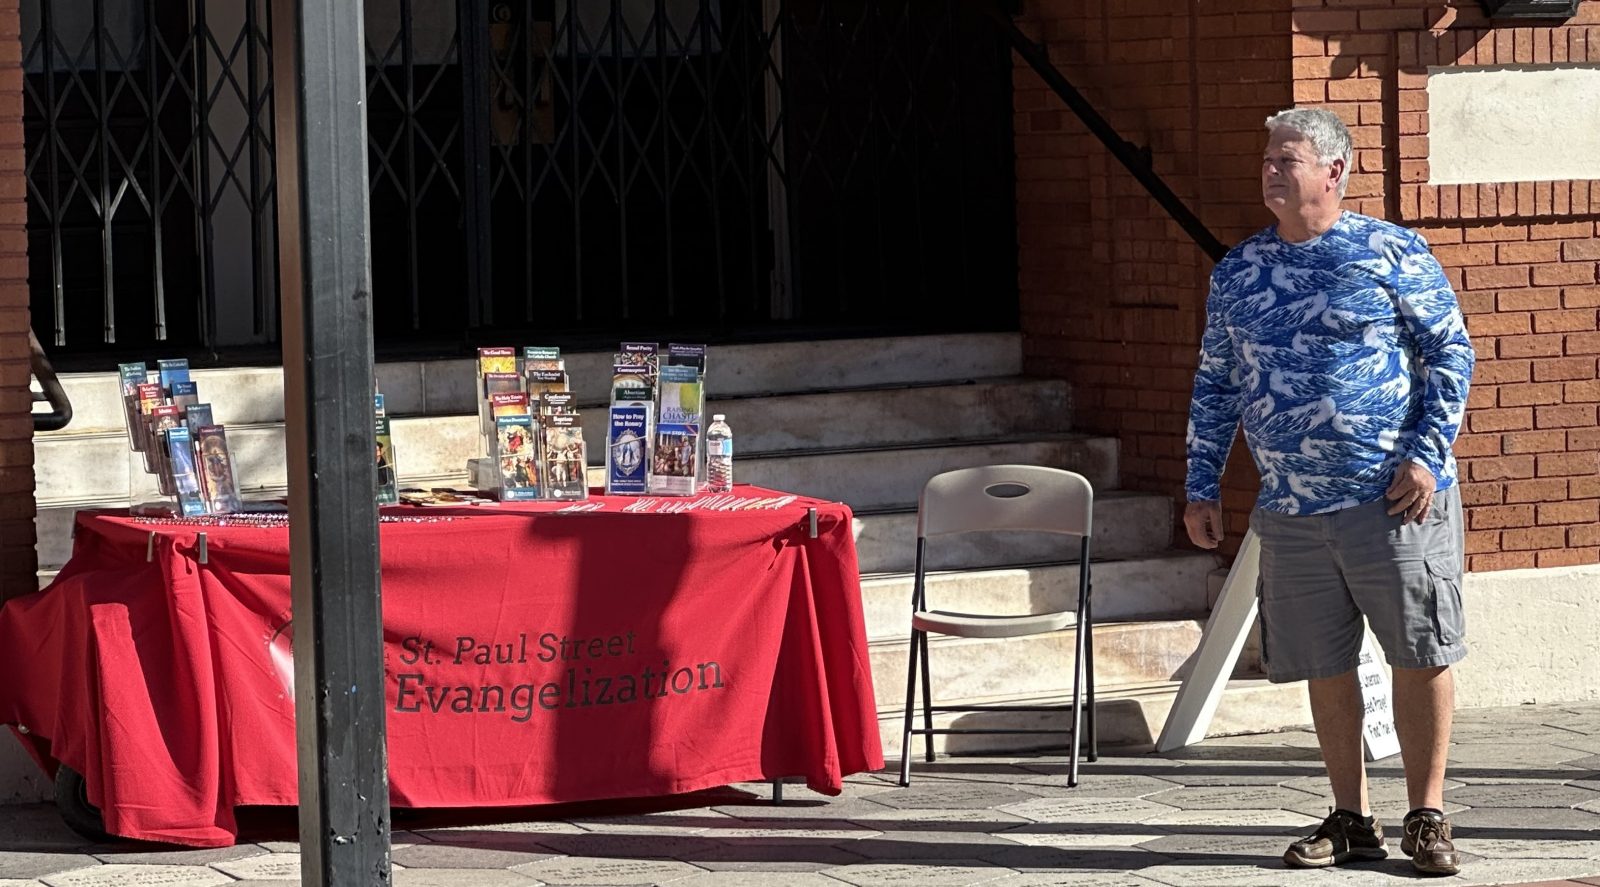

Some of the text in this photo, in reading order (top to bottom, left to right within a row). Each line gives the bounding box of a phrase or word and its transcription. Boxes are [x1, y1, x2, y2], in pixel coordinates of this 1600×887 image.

[400, 636, 442, 666] St.
[453, 633, 527, 666] Paul
[536, 630, 636, 664] Street
[393, 659, 725, 723] Evangelization
